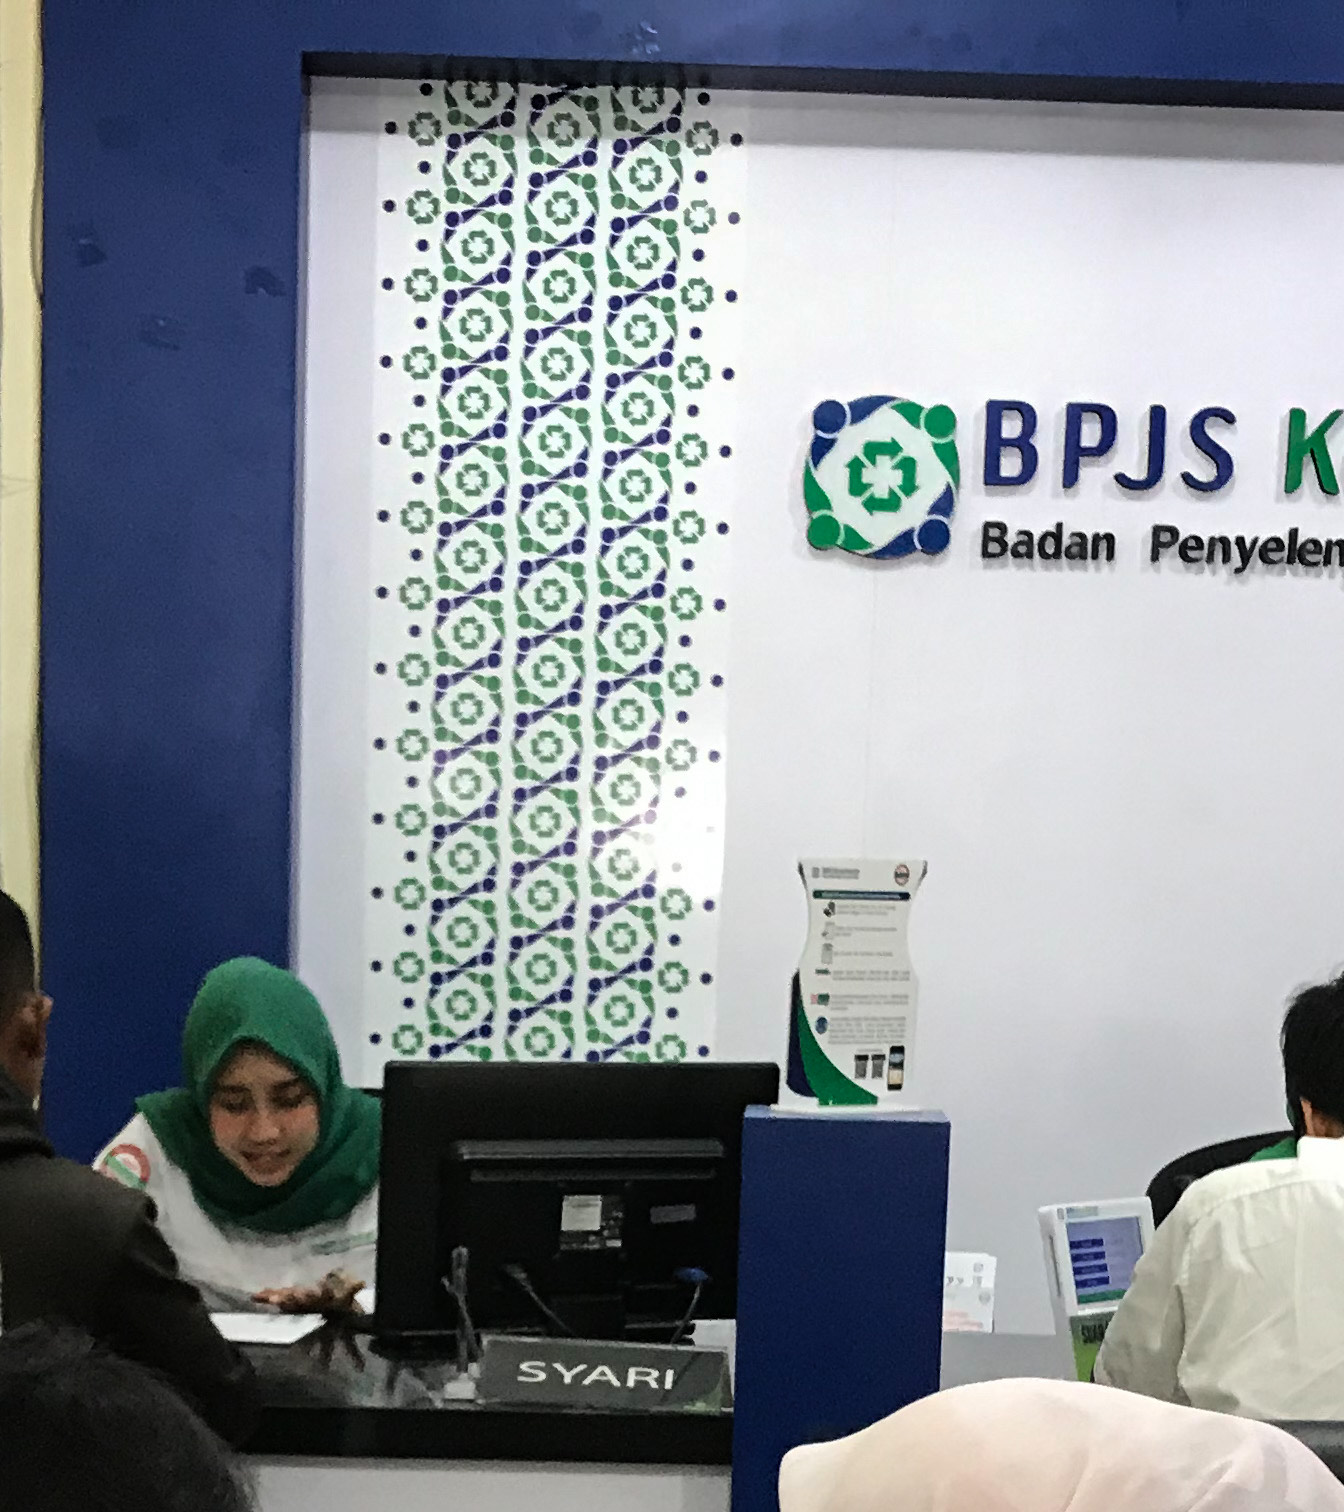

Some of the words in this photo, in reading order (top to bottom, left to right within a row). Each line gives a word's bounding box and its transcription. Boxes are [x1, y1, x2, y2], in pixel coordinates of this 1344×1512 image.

[982, 399, 1237, 495] BPJS
[980, 521, 1116, 563] Badan
[517, 1361, 675, 1390] SYARI
